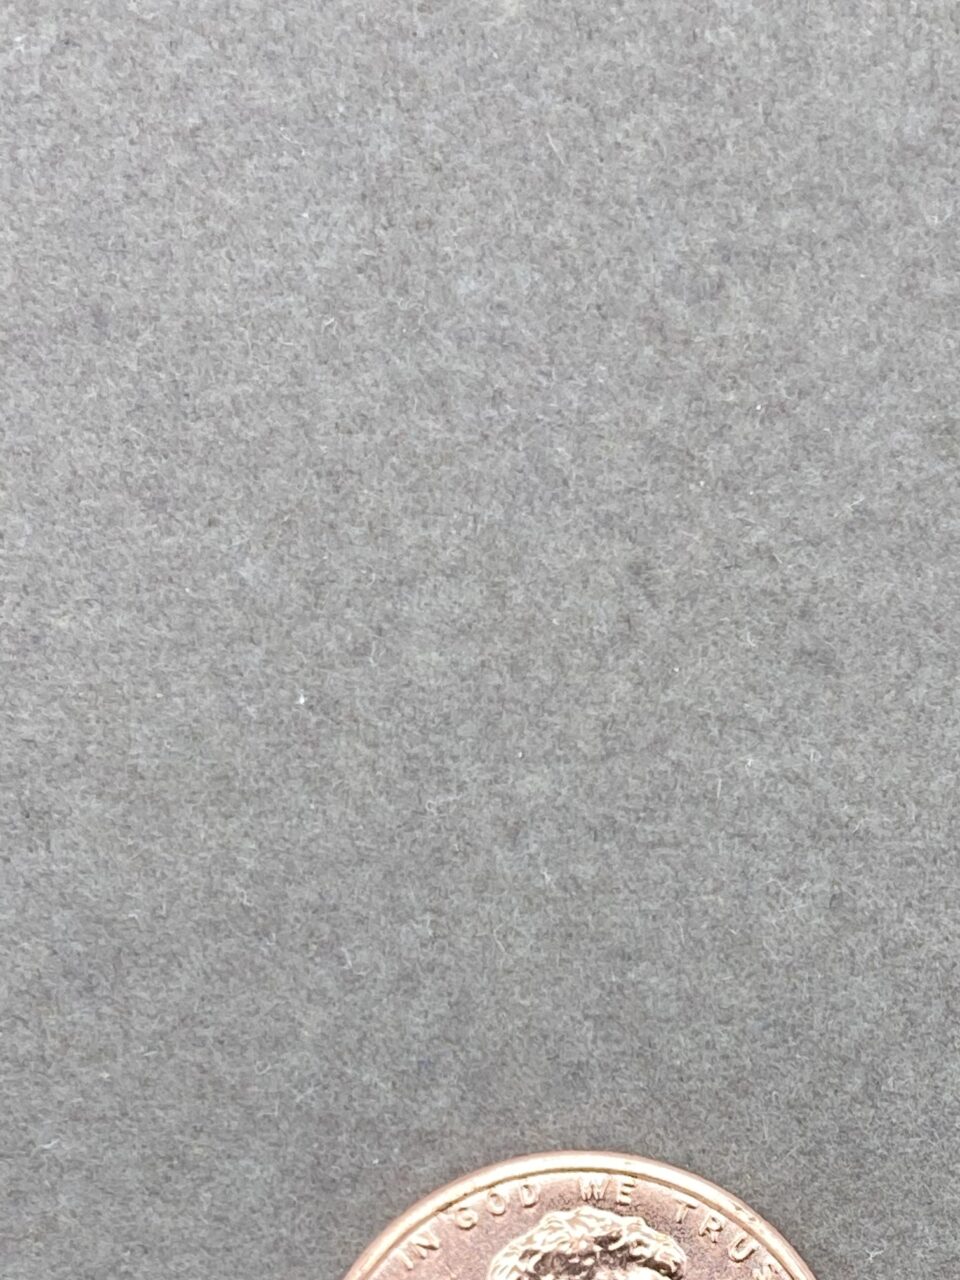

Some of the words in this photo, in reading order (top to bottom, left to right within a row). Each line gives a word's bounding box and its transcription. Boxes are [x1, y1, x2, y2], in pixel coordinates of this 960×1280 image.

[399, 1228, 441, 1271] IN
[454, 1182, 542, 1231] GOD
[577, 1173, 637, 1206] WE
